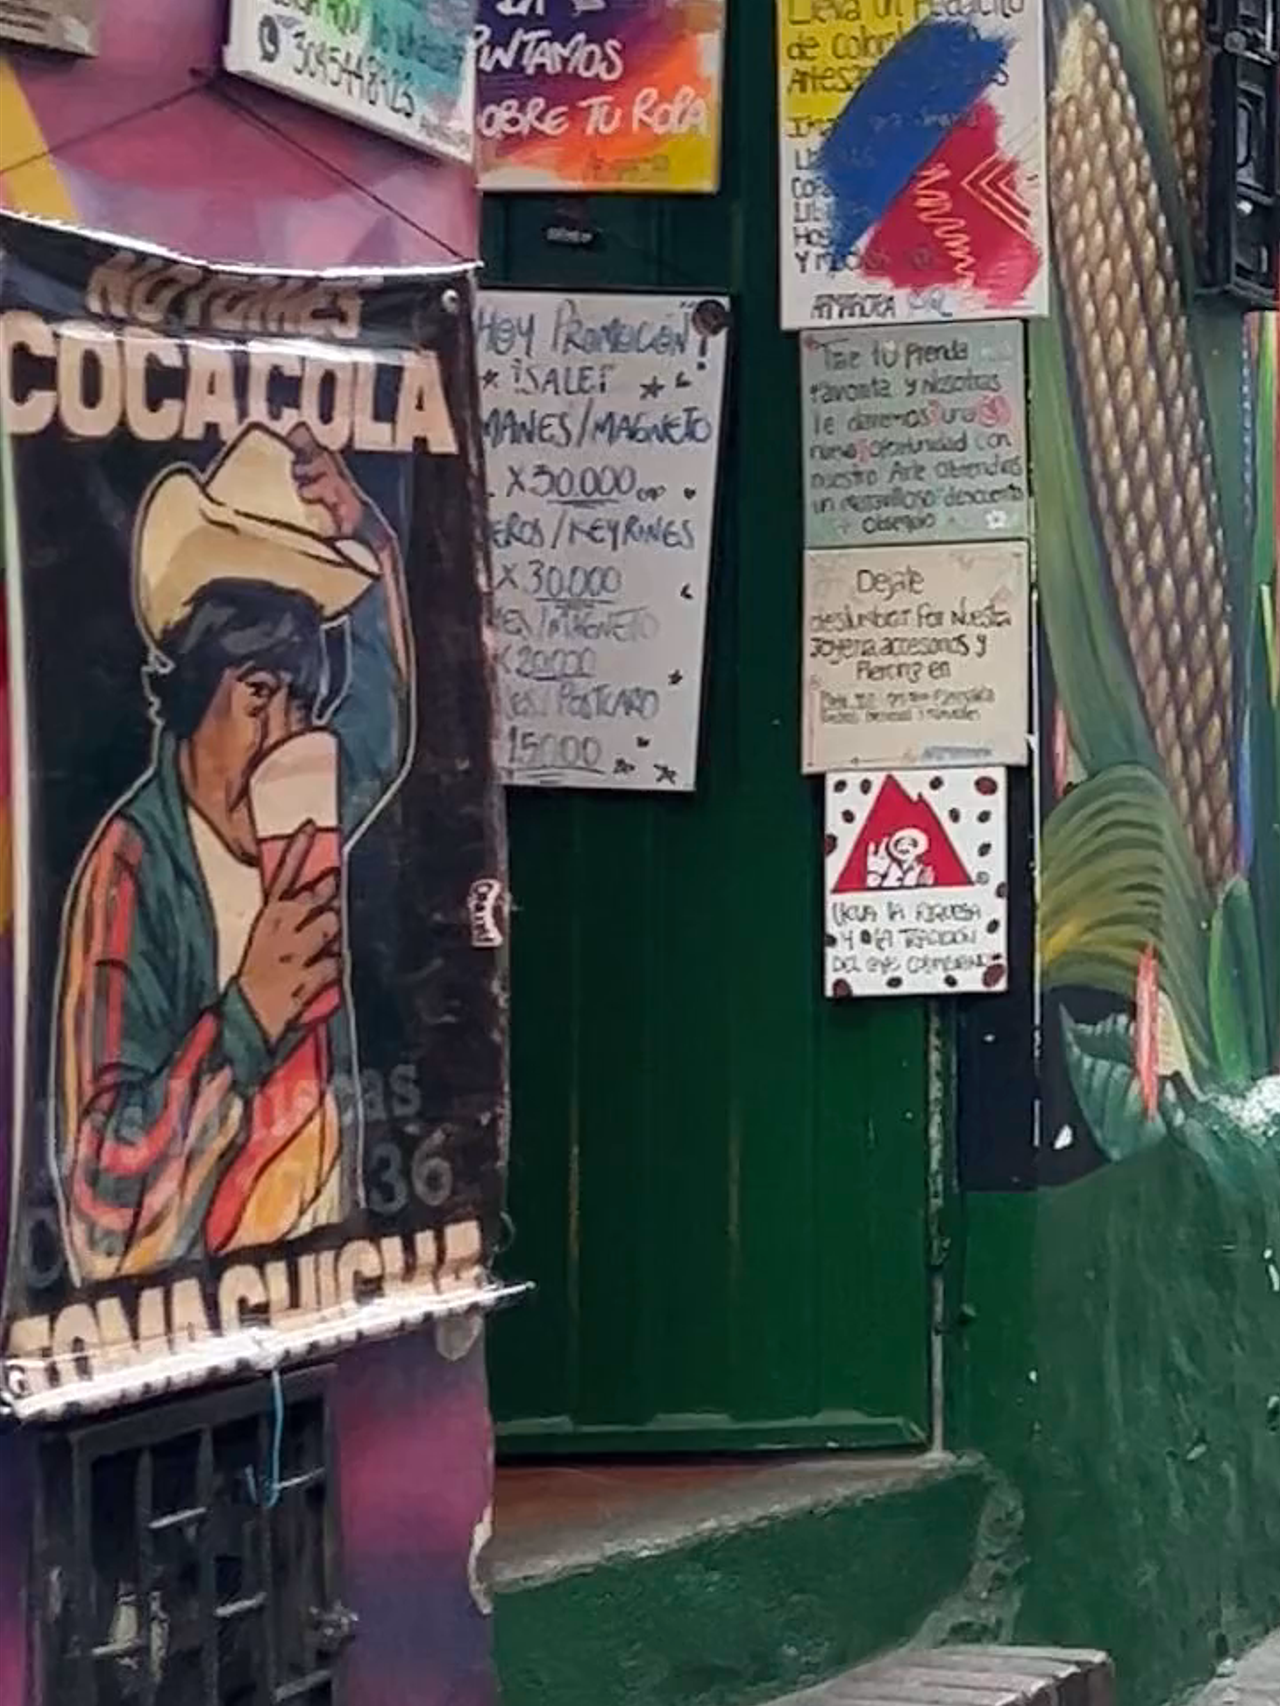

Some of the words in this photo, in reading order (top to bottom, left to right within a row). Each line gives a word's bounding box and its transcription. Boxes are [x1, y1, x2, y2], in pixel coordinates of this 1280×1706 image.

[479, 97, 570, 137] OBRE
[576, 95, 622, 135] TU
[632, 85, 709, 135] ROPA
[1, 310, 459, 455] COCACOLA
[480, 397, 713, 449] MANES/MAGNETO
[488, 511, 695, 552] EROS/KEYRINGS
